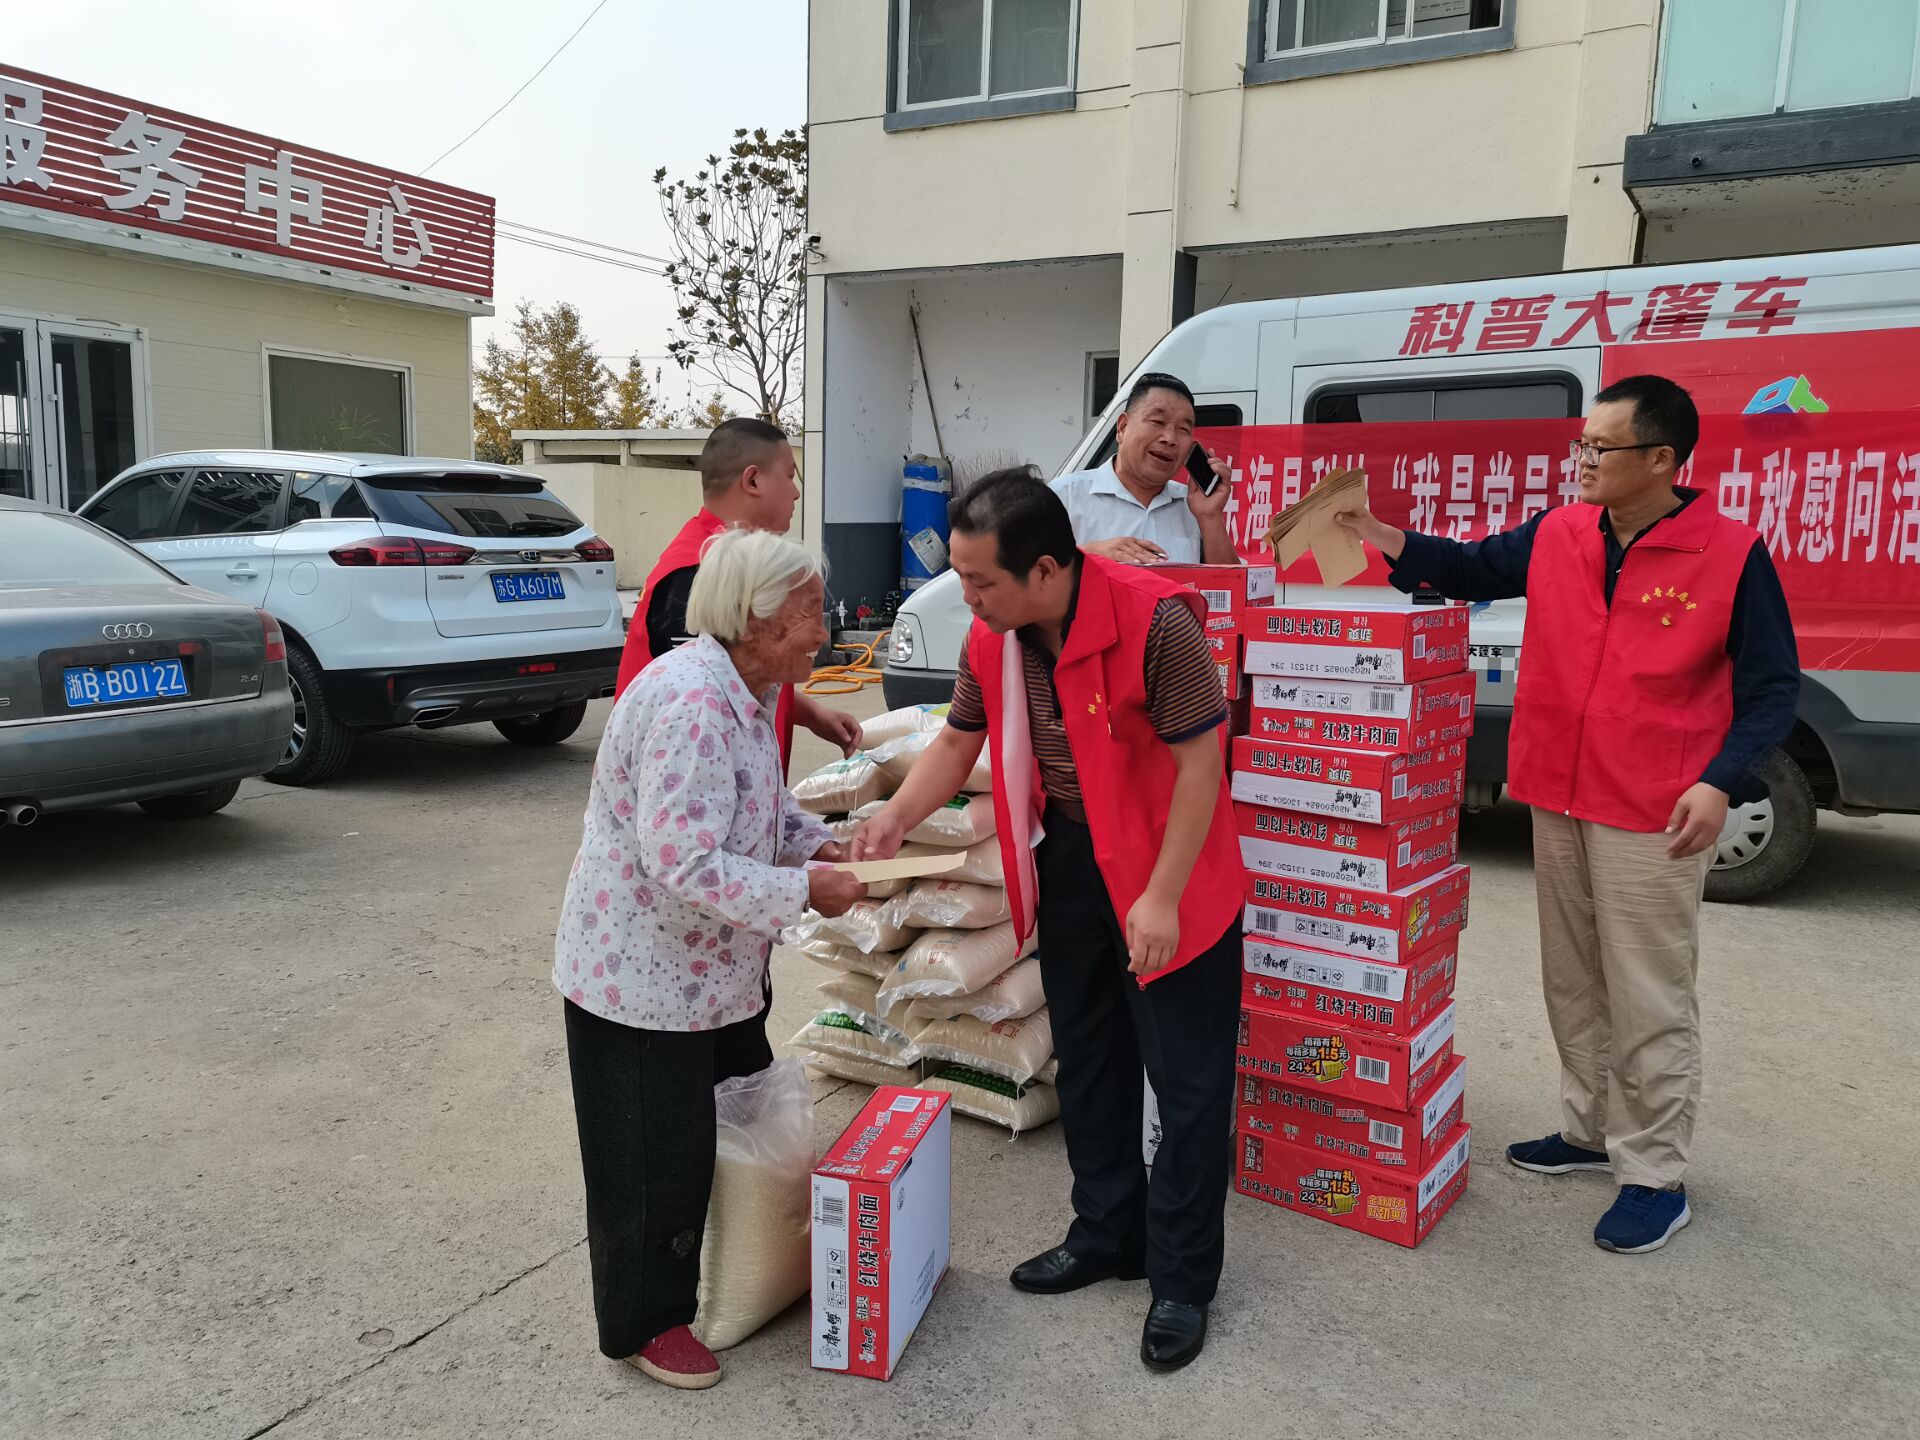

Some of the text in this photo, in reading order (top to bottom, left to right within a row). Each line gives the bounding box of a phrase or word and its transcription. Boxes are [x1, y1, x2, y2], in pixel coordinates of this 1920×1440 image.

[1398, 276, 1808, 356] 科普大篷车
[1266, 615, 1342, 638] 红烧牛肉面
[1322, 722, 1399, 747] 红烧牛肉面
[1251, 749, 1322, 773] 红烧牛肉面
[1255, 813, 1328, 842] 红烧牛肉面
[1254, 880, 1327, 909] 红烧牛肉面
[1315, 993, 1395, 1025] 红烧牛肉面
[1288, 1060, 1321, 1075] 24+1
[1268, 1088, 1334, 1117] 红烧牛肉面
[1315, 1134, 1369, 1158] 红烧牛肉面
[1240, 1177, 1295, 1204] 红烧牛肉面
[1300, 1190, 1333, 1206] 24+1
[858, 1194, 880, 1288] 红烧牛肉面
